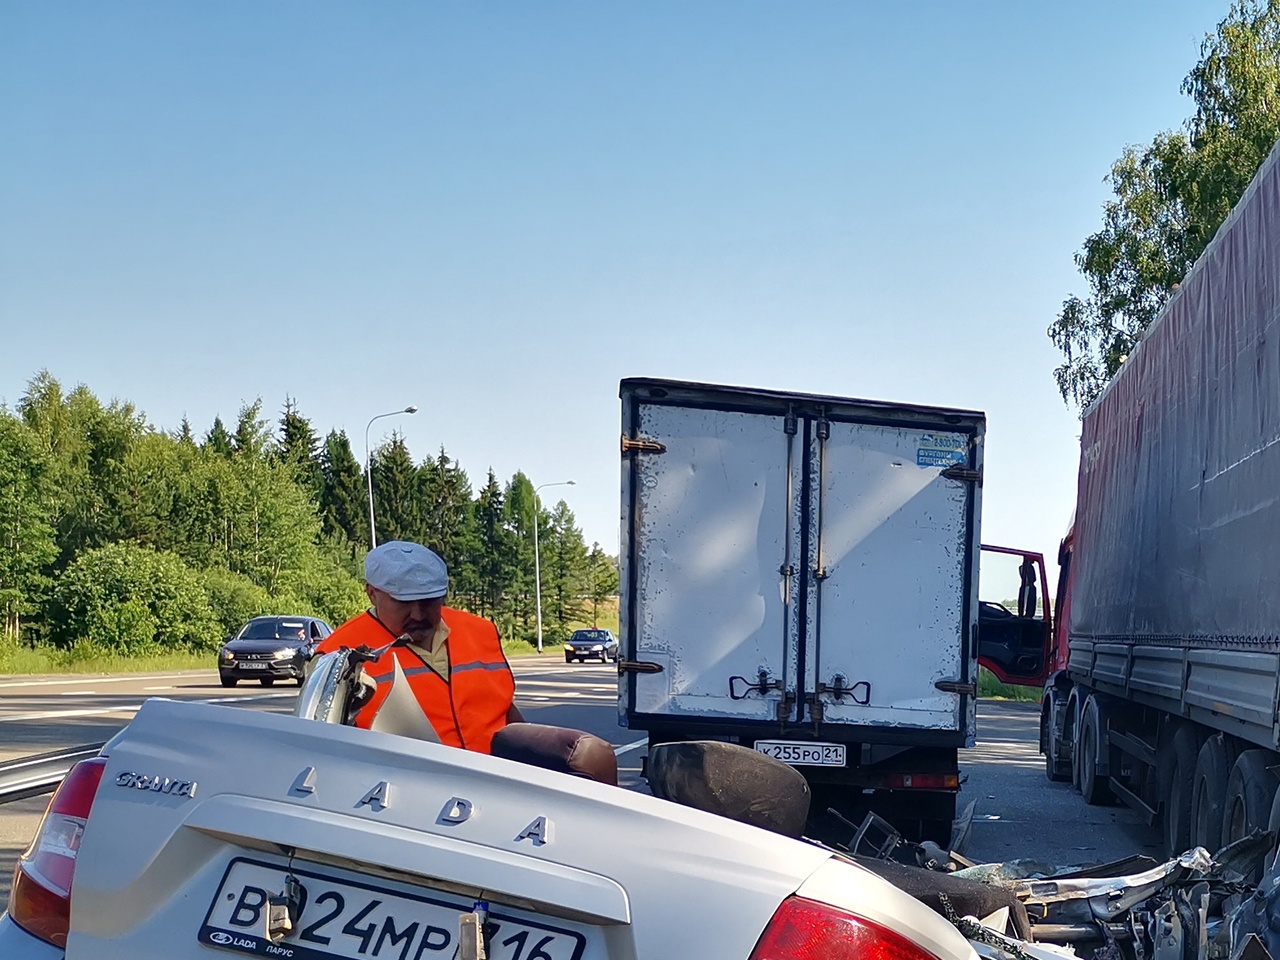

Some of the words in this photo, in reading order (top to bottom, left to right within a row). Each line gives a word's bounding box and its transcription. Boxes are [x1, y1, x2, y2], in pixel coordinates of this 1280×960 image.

[115, 771, 198, 799] GRANTA
[293, 766, 550, 845] LADA
[232, 937, 257, 950] LADA
[266, 945, 294, 958] ПАРУС
